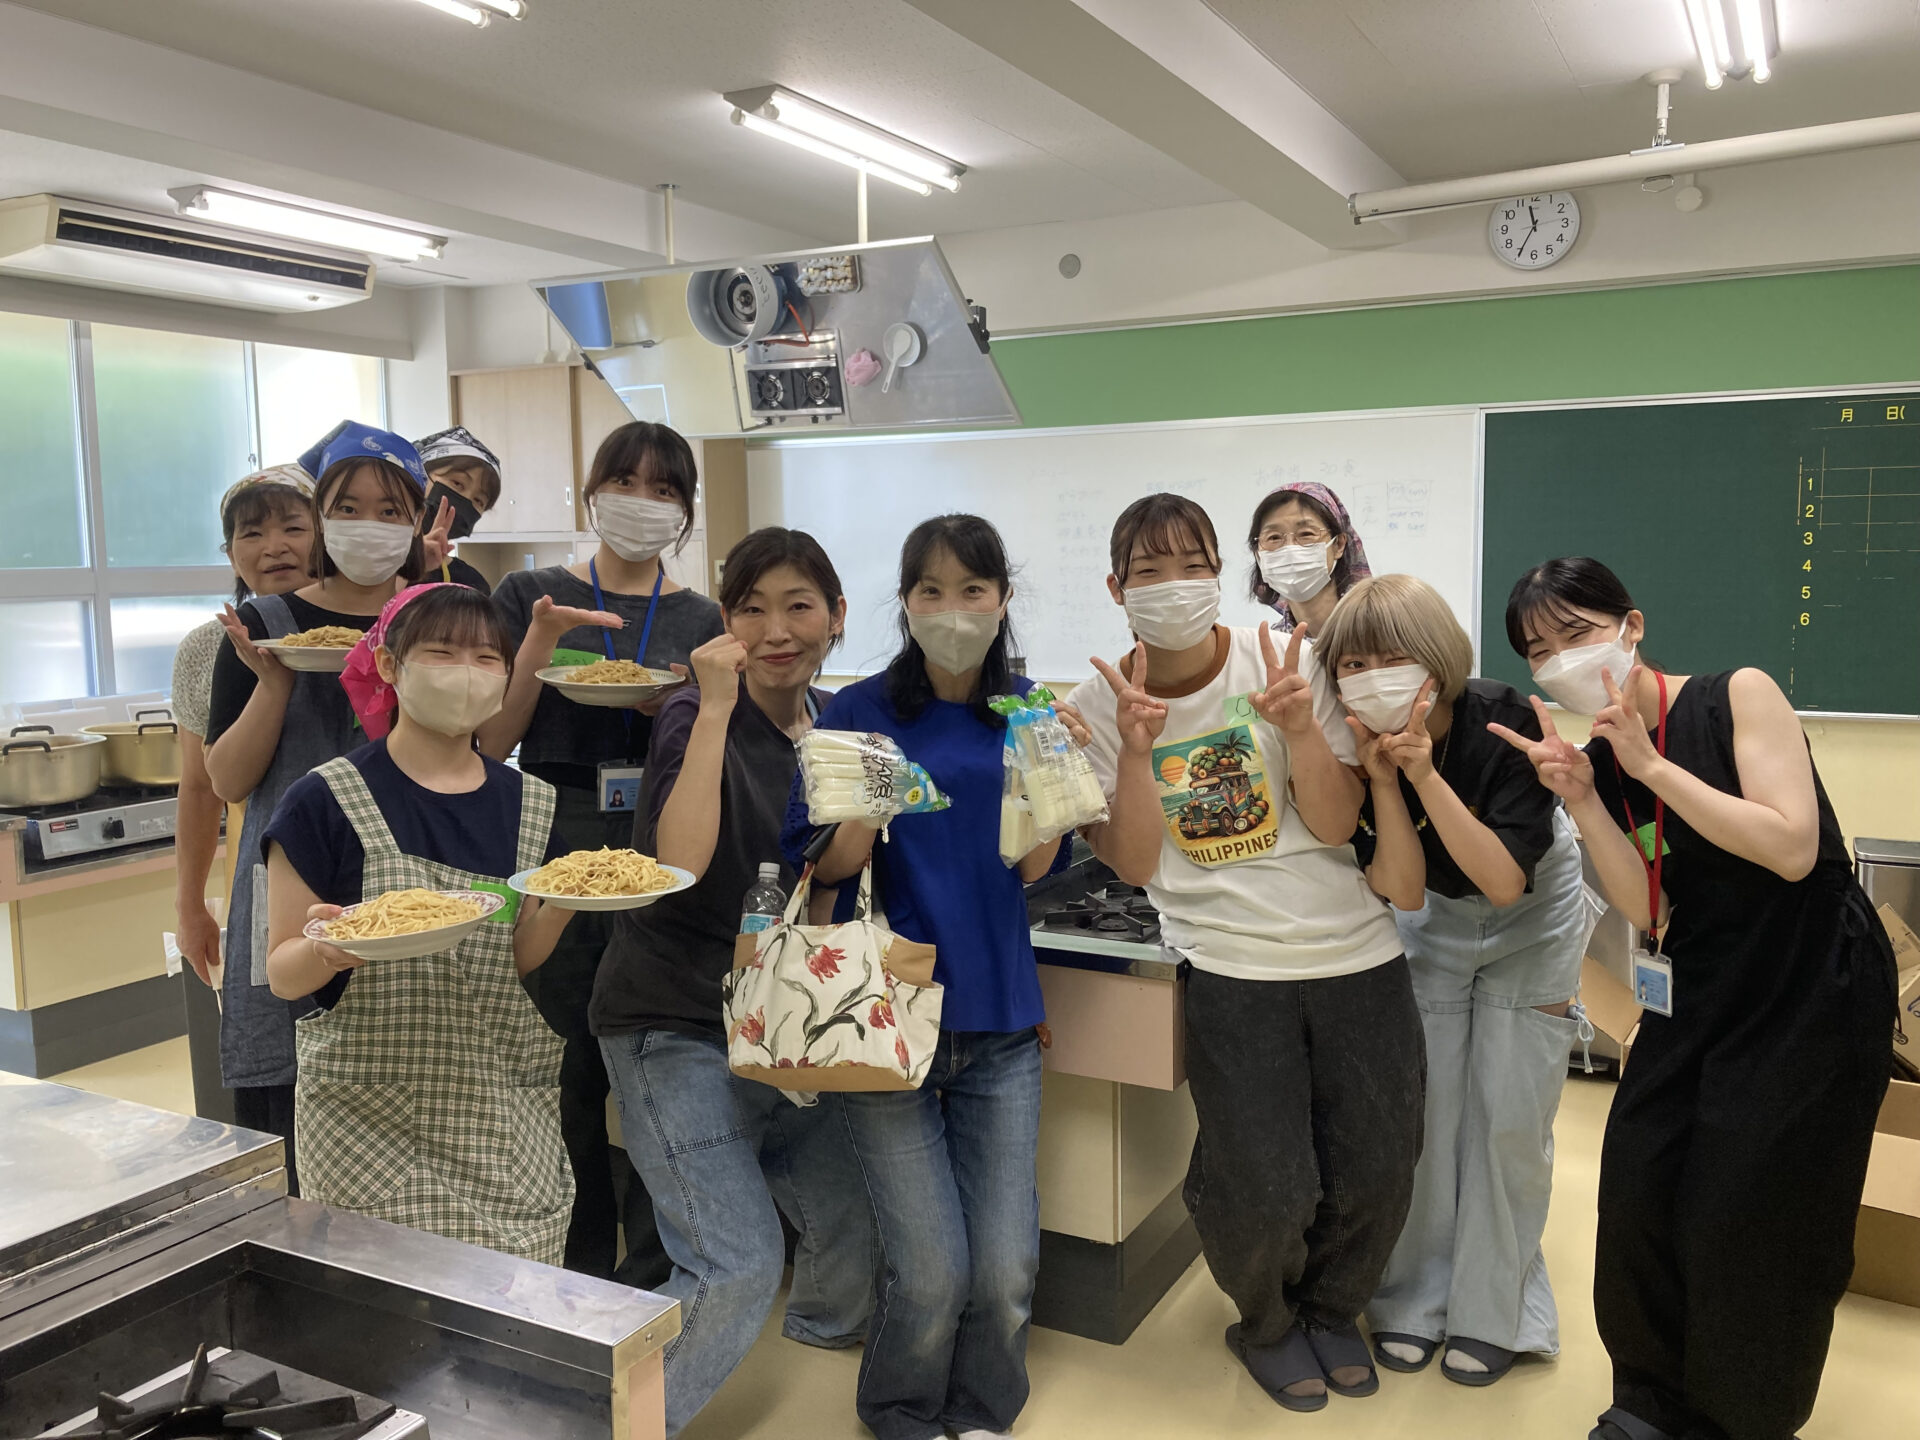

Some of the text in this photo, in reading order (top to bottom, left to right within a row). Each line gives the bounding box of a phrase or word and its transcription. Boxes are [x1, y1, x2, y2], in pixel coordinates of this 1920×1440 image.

[1504, 209, 1516, 220] 10
[1557, 203, 1565, 214] 2
[1561, 217, 1569, 229] 3
[1500, 224, 1509, 235] 9
[1505, 238, 1513, 249] 8
[1556, 233, 1564, 243] 4
[1530, 249, 1538, 260] 6
[1545, 244, 1553, 255] 5
[1840, 408, 1854, 422] 月
[1807, 477, 1814, 491] 1
[1805, 504, 1815, 518] 2
[1803, 531, 1813, 546] 3
[1802, 559, 1812, 573] 4
[1801, 585, 1811, 599] 5
[1800, 612, 1810, 626] 6
